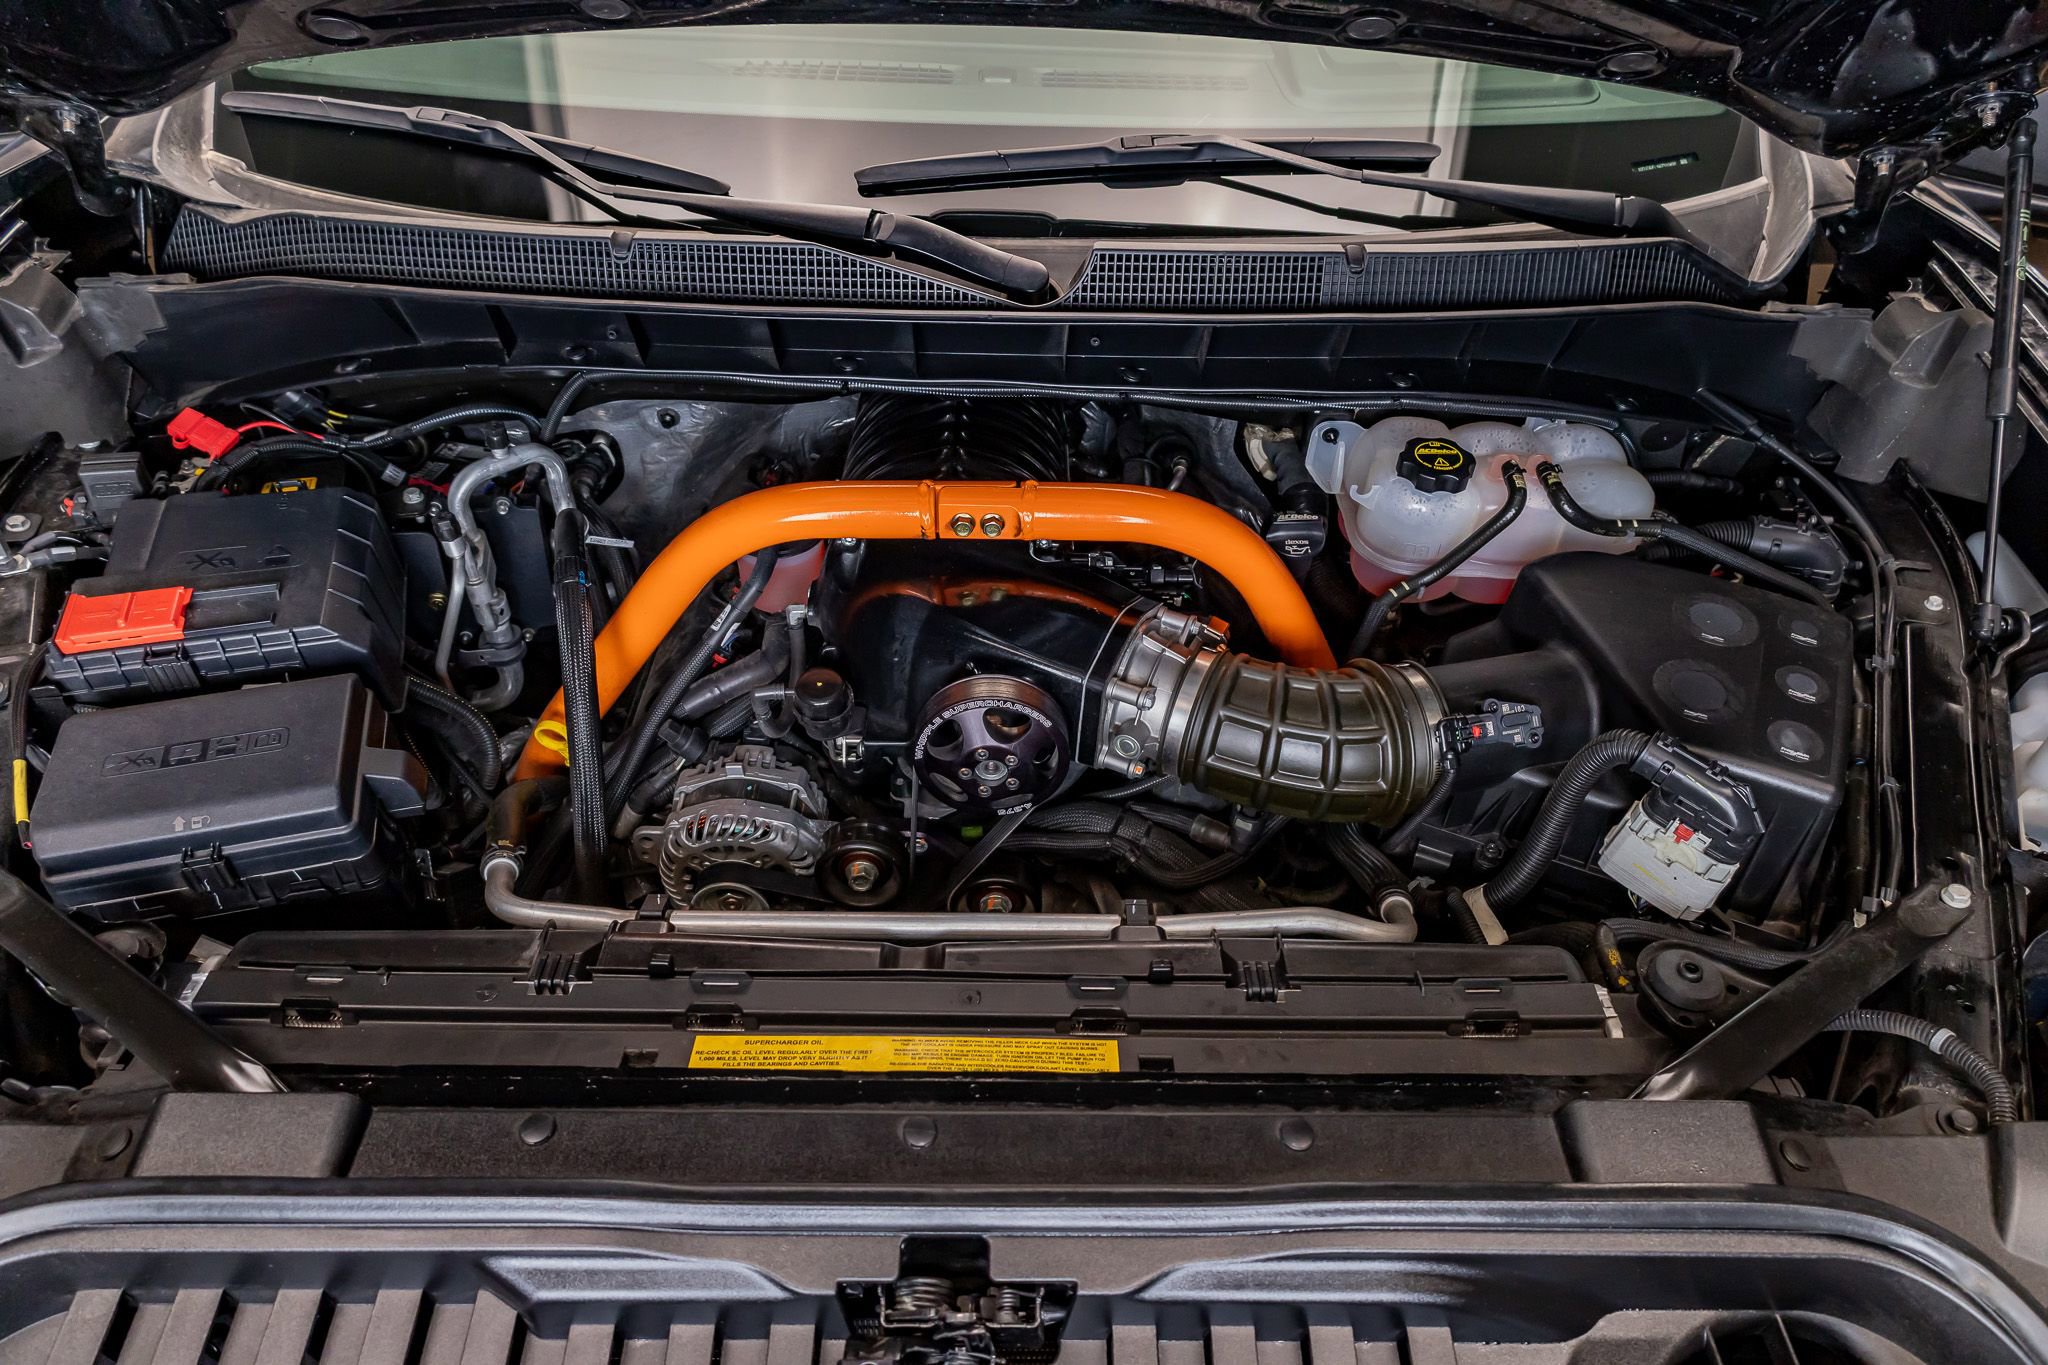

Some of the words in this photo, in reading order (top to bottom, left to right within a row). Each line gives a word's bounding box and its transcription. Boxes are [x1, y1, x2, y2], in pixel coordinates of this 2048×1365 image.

[915, 716, 944, 760] WHIPPLE
[943, 700, 1053, 728] SUPERCHARGERS
[997, 802, 1032, 816] 4.375
